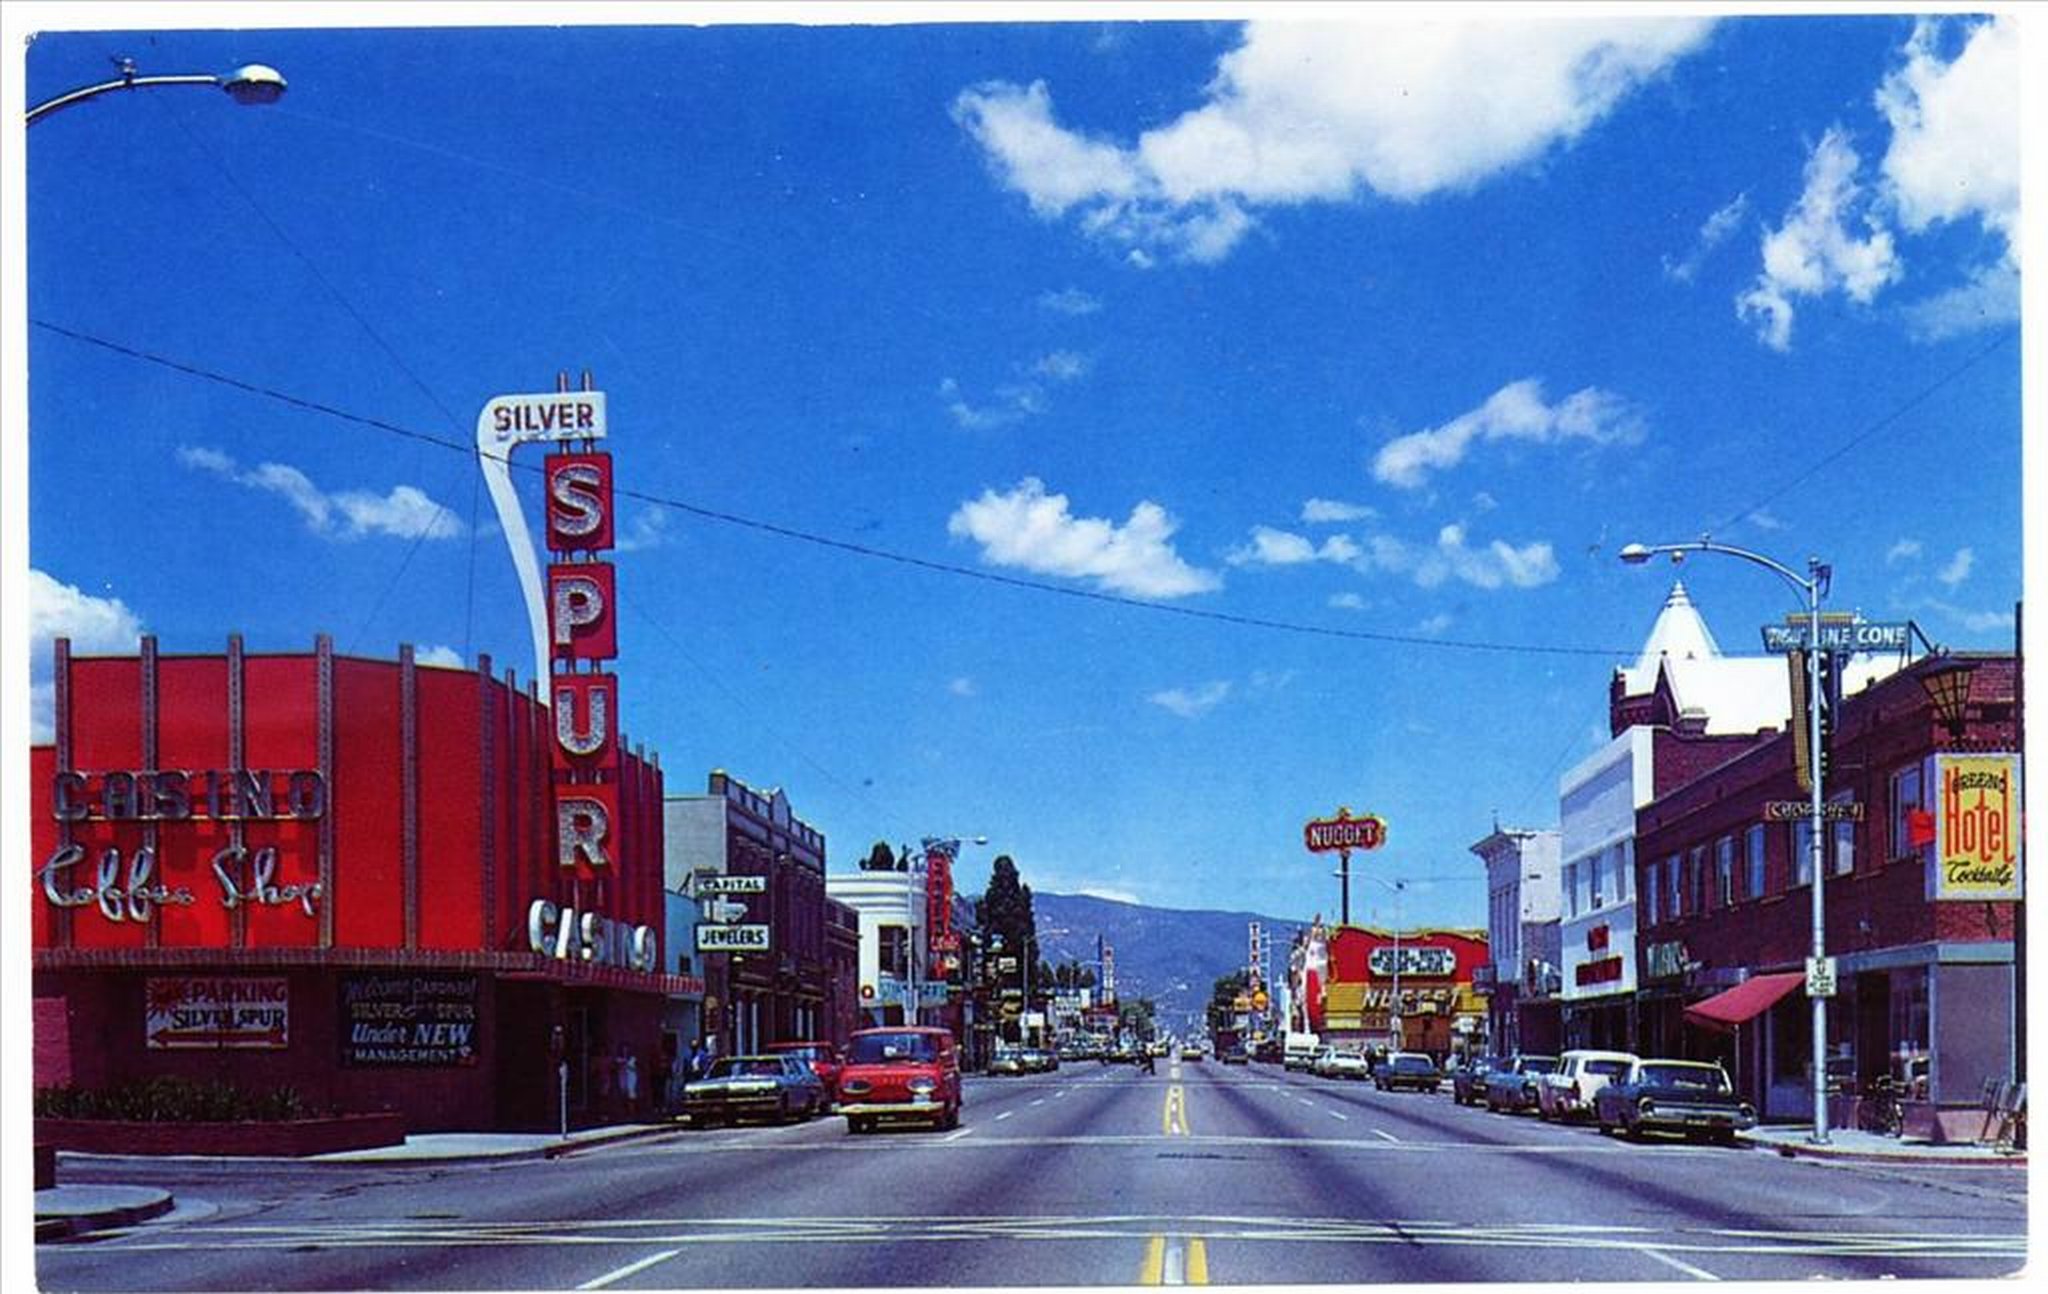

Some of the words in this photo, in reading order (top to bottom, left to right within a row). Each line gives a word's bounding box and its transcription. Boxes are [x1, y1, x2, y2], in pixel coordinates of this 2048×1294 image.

[493, 403, 594, 432] SILVER
[1857, 626, 1907, 645] CONE
[551, 462, 609, 867] SPUR
[54, 771, 325, 819] CASINO
[1944, 765, 2016, 864] Hotel
[1310, 822, 1377, 847] NUGGET
[35, 845, 195, 922] Coffee
[212, 845, 321, 916] Shop
[703, 879, 761, 890] CAPITAL
[528, 899, 657, 973] CASINO
[702, 929, 765, 945] JEWELERS
[191, 981, 286, 1003] PARKING
[236, 1008, 286, 1033] SPUR
[351, 1021, 407, 1043] Under
[413, 1023, 473, 1045] NEW
[354, 1048, 457, 1062] MANAGEMENT
